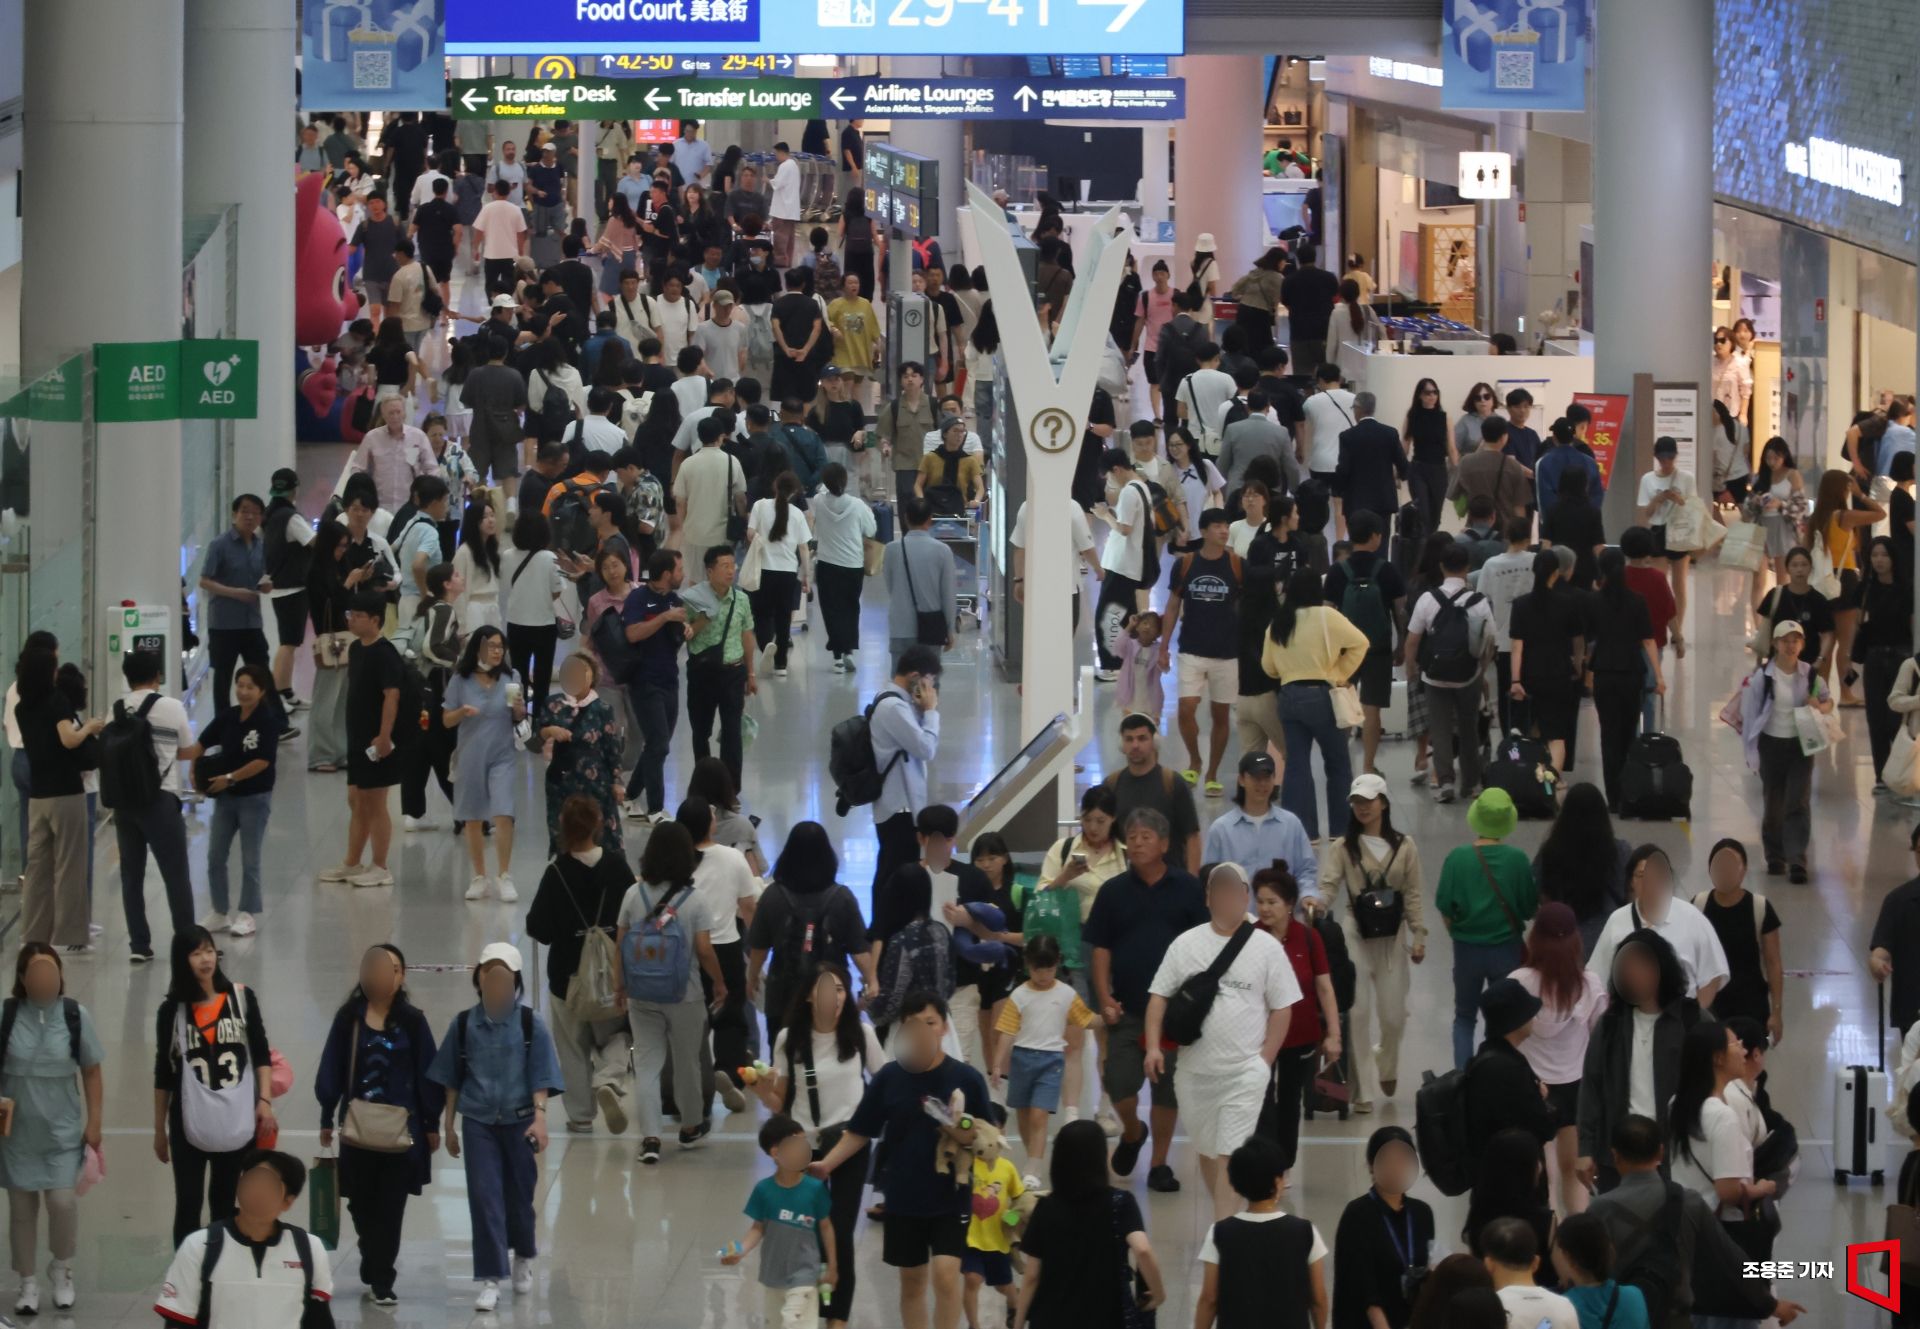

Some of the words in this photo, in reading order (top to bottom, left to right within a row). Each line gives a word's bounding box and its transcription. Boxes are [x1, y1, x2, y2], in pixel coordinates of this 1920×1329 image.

[576, 0, 626, 21] Food
[629, 0, 687, 22] Court,
[682, 60, 710, 70] Gates
[494, 85, 570, 103] Transfer
[573, 85, 617, 102] Desk
[677, 88, 746, 107] Transfer
[749, 89, 812, 111] Lounge
[863, 84, 921, 102] Airline
[923, 85, 995, 105] Lounges
[494, 105, 525, 115] Other
[526, 105, 566, 115] Airlines
[864, 105, 891, 113] Asiana
[924, 105, 964, 115] Singapore
[965, 105, 994, 113] Airlines
[128, 364, 166, 382] AED
[199, 390, 235, 404] AED
[138, 637, 161, 648] AED
